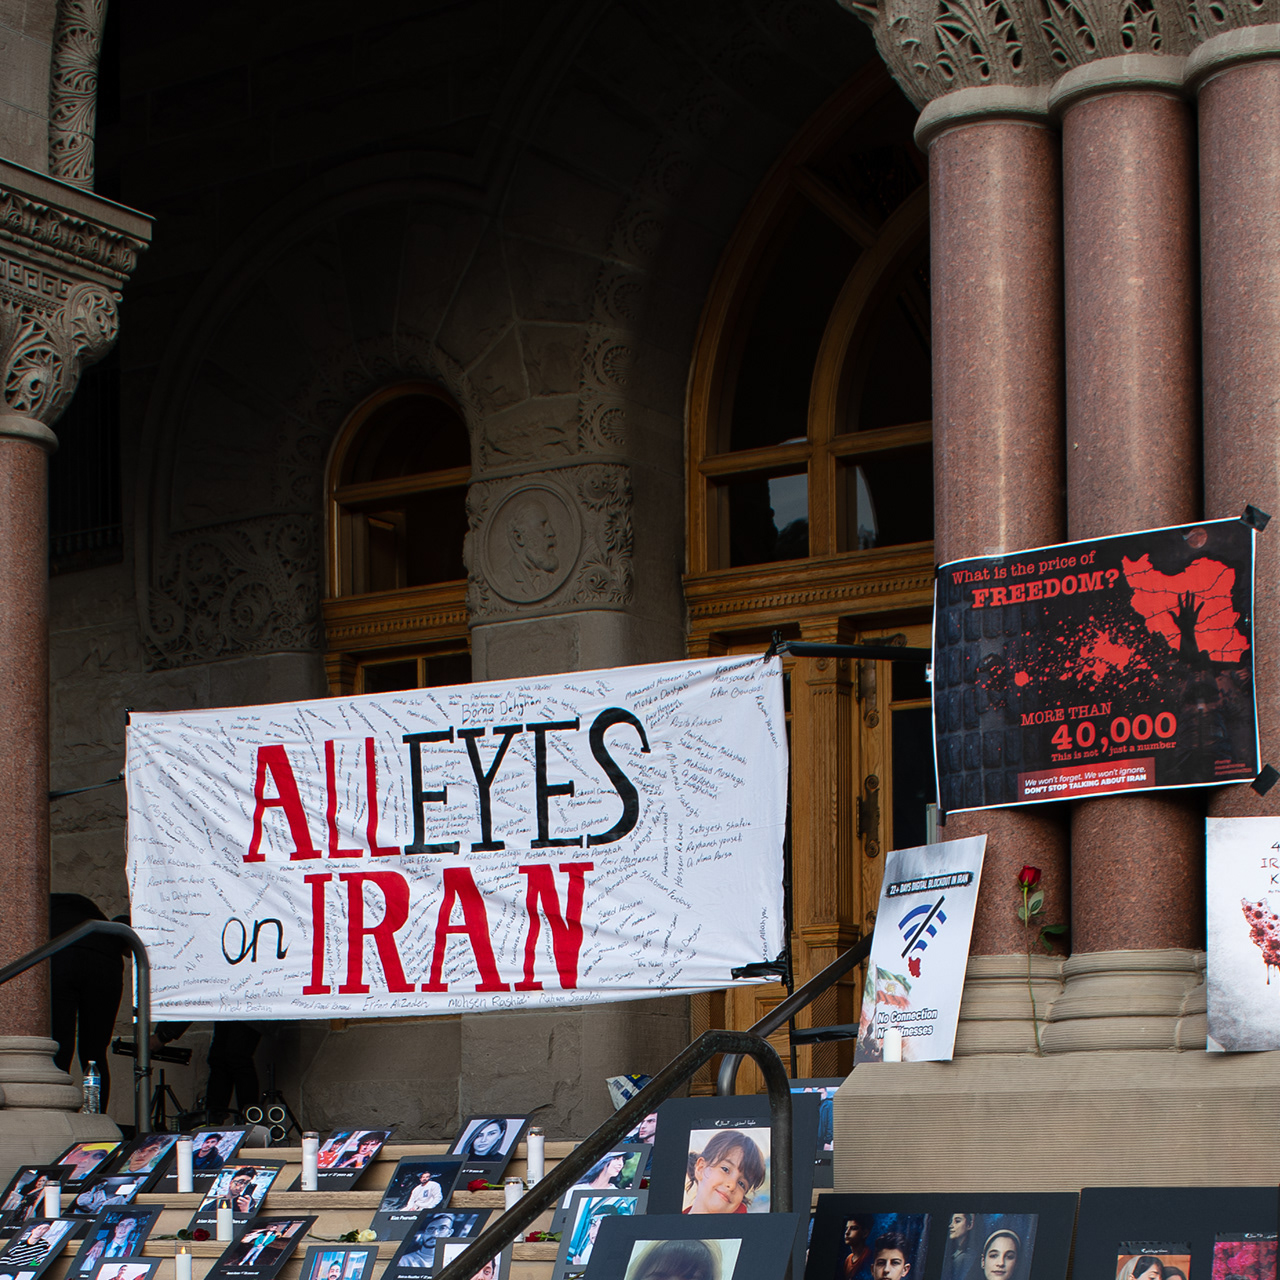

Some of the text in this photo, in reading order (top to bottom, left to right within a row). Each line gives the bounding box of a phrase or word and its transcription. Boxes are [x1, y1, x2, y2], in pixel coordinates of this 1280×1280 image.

[952, 550, 1096, 585] What is the price of
[971, 568, 1120, 609] FREEDOM?
[1020, 702, 1112, 727] MORE THAN
[1051, 712, 1178, 753] 40,000
[1051, 751, 1071, 763] This
[1073, 751, 1082, 760] is
[1083, 749, 1099, 760] not
[1108, 744, 1127, 757] just
[1137, 740, 1177, 753] number
[243, 737, 401, 862] ALL
[402, 707, 651, 855] EYES
[1024, 774, 1147, 795] DON'T STOP TALKING ABOUT IRAN
[1025, 767, 1146, 787] We won't forget. We won't ignore.
[221, 862, 594, 995] on IRAN
[877, 1008, 938, 1024] No Connection
